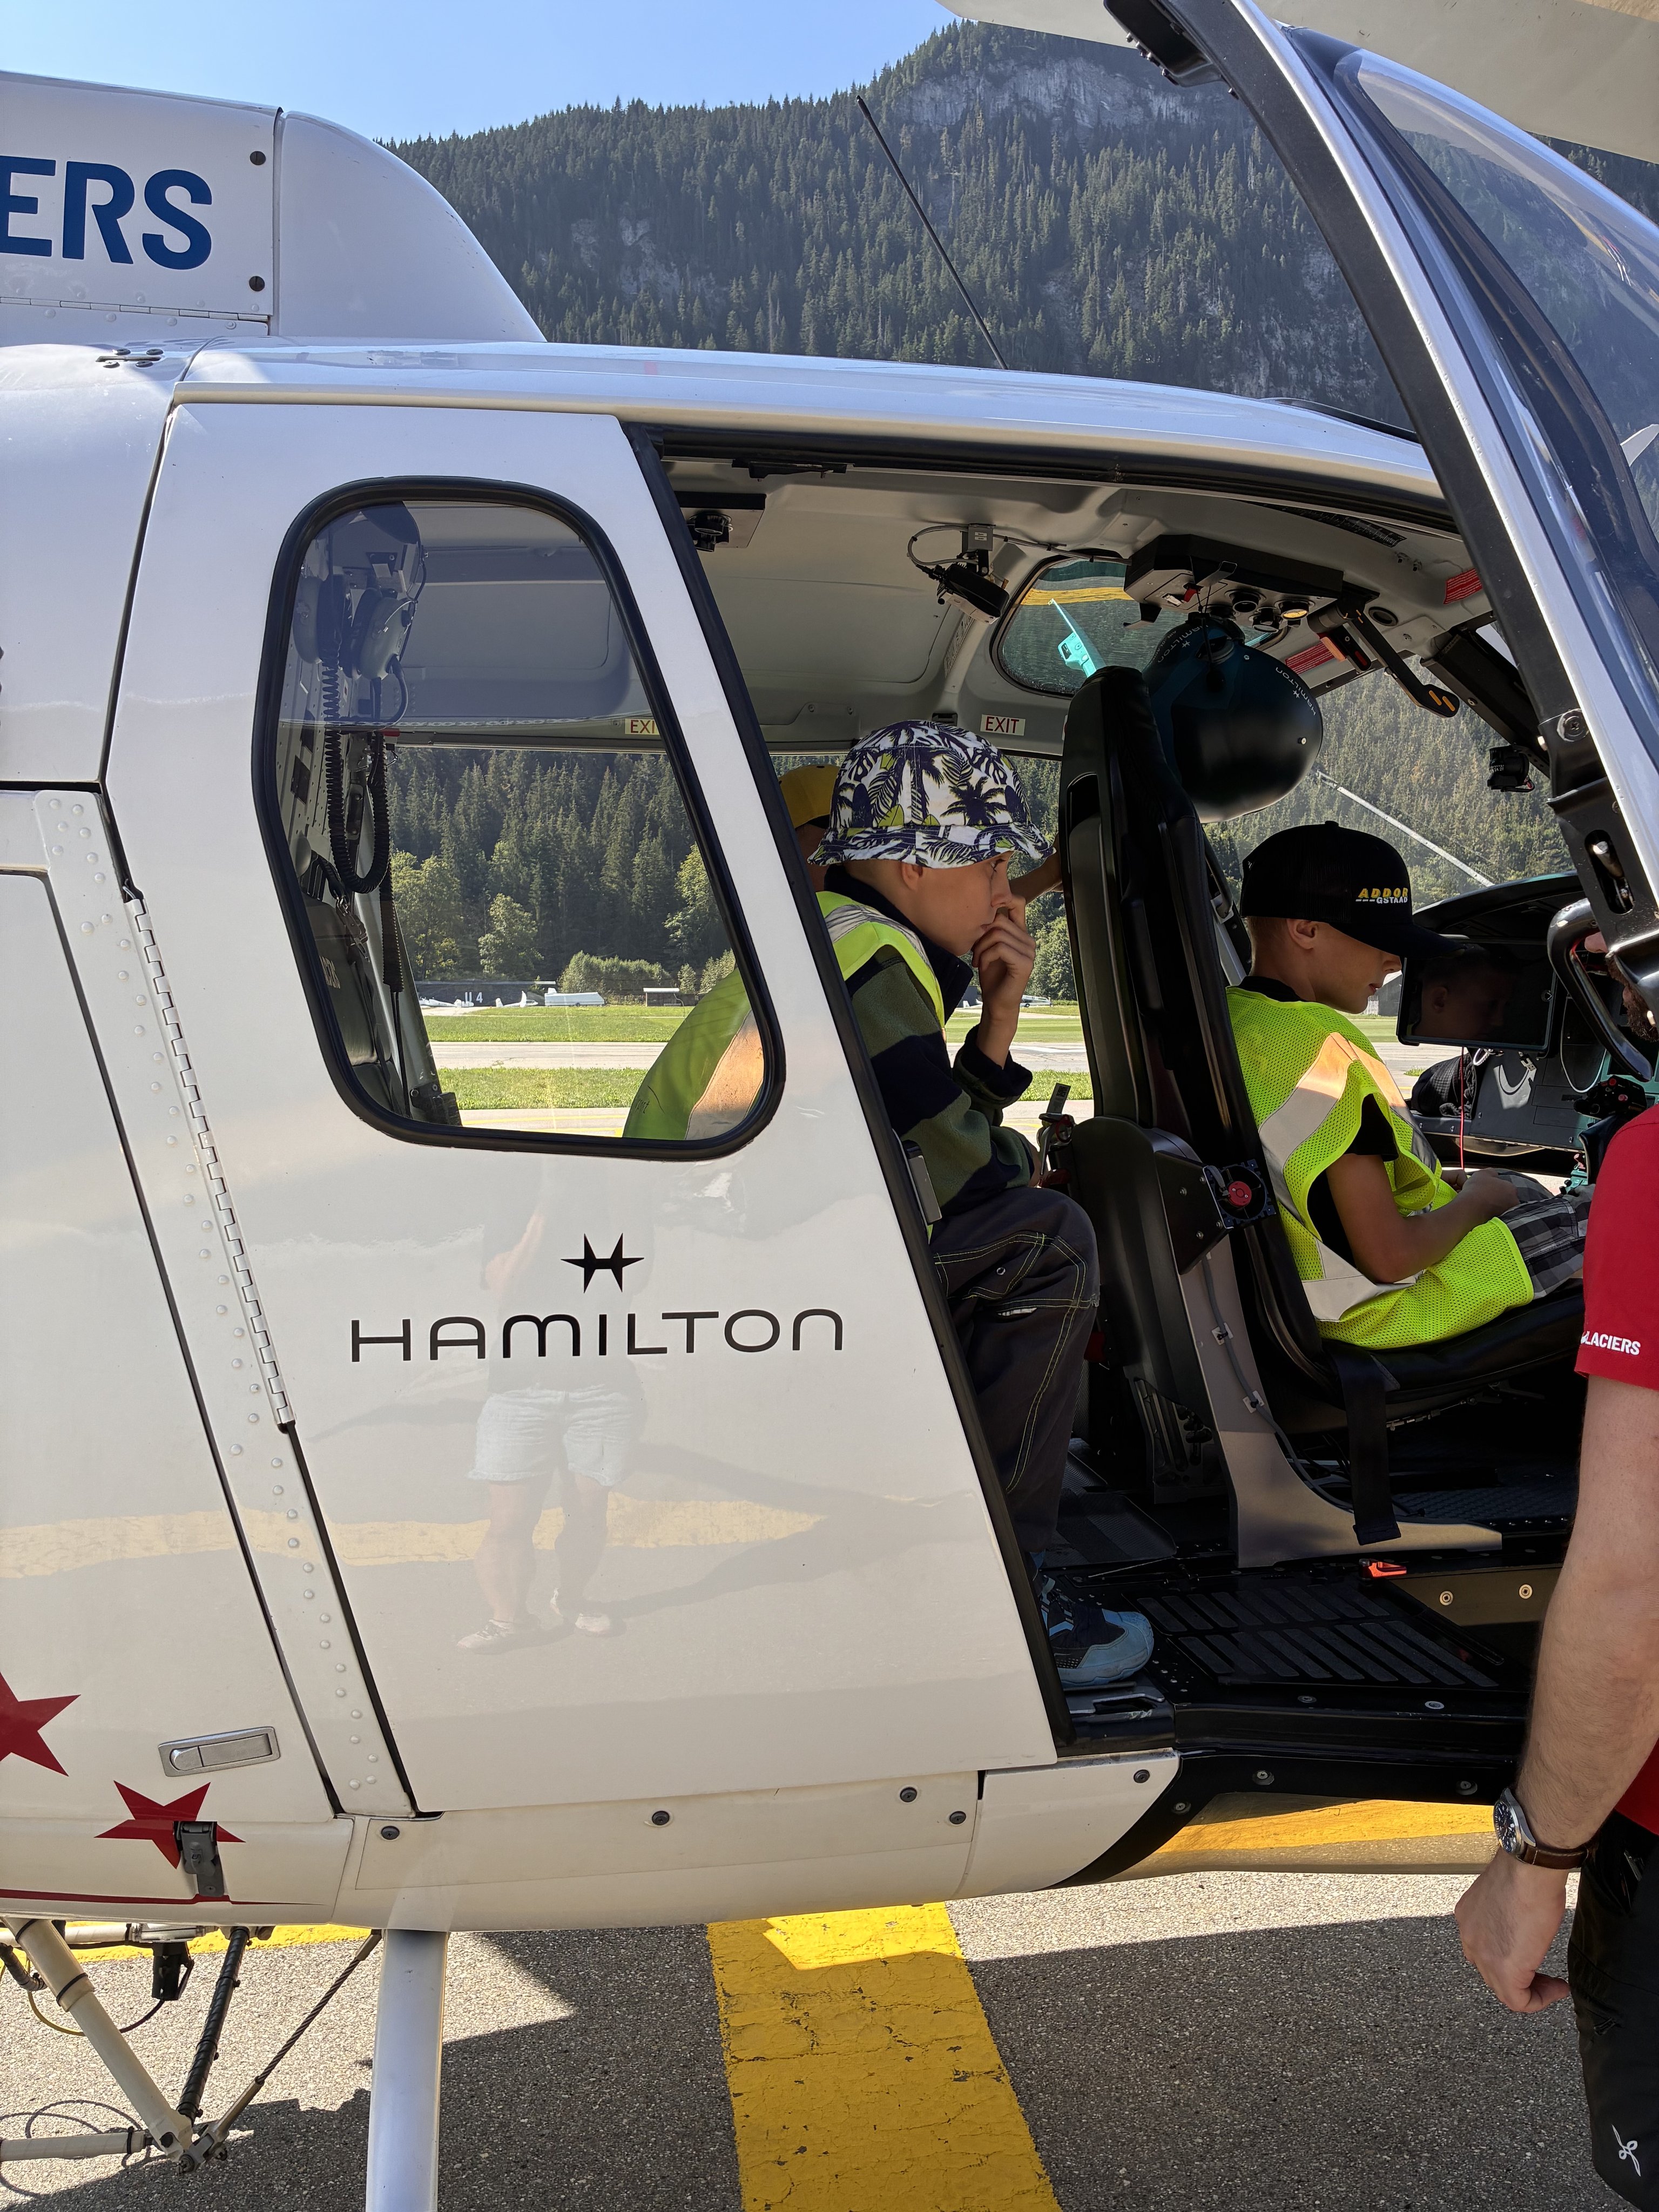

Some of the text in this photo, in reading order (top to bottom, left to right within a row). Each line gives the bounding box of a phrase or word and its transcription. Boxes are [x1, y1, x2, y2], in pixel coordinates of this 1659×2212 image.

[0, 155, 212, 269] ERS
[1275, 666, 1316, 716] HAMILTON
[630, 719, 655, 734] EXI
[985, 716, 1020, 733] EXIT
[1358, 887, 1408, 899] ADDOR
[1376, 896, 1408, 905] GSTAAD
[351, 1309, 843, 1362] HAMILTON
